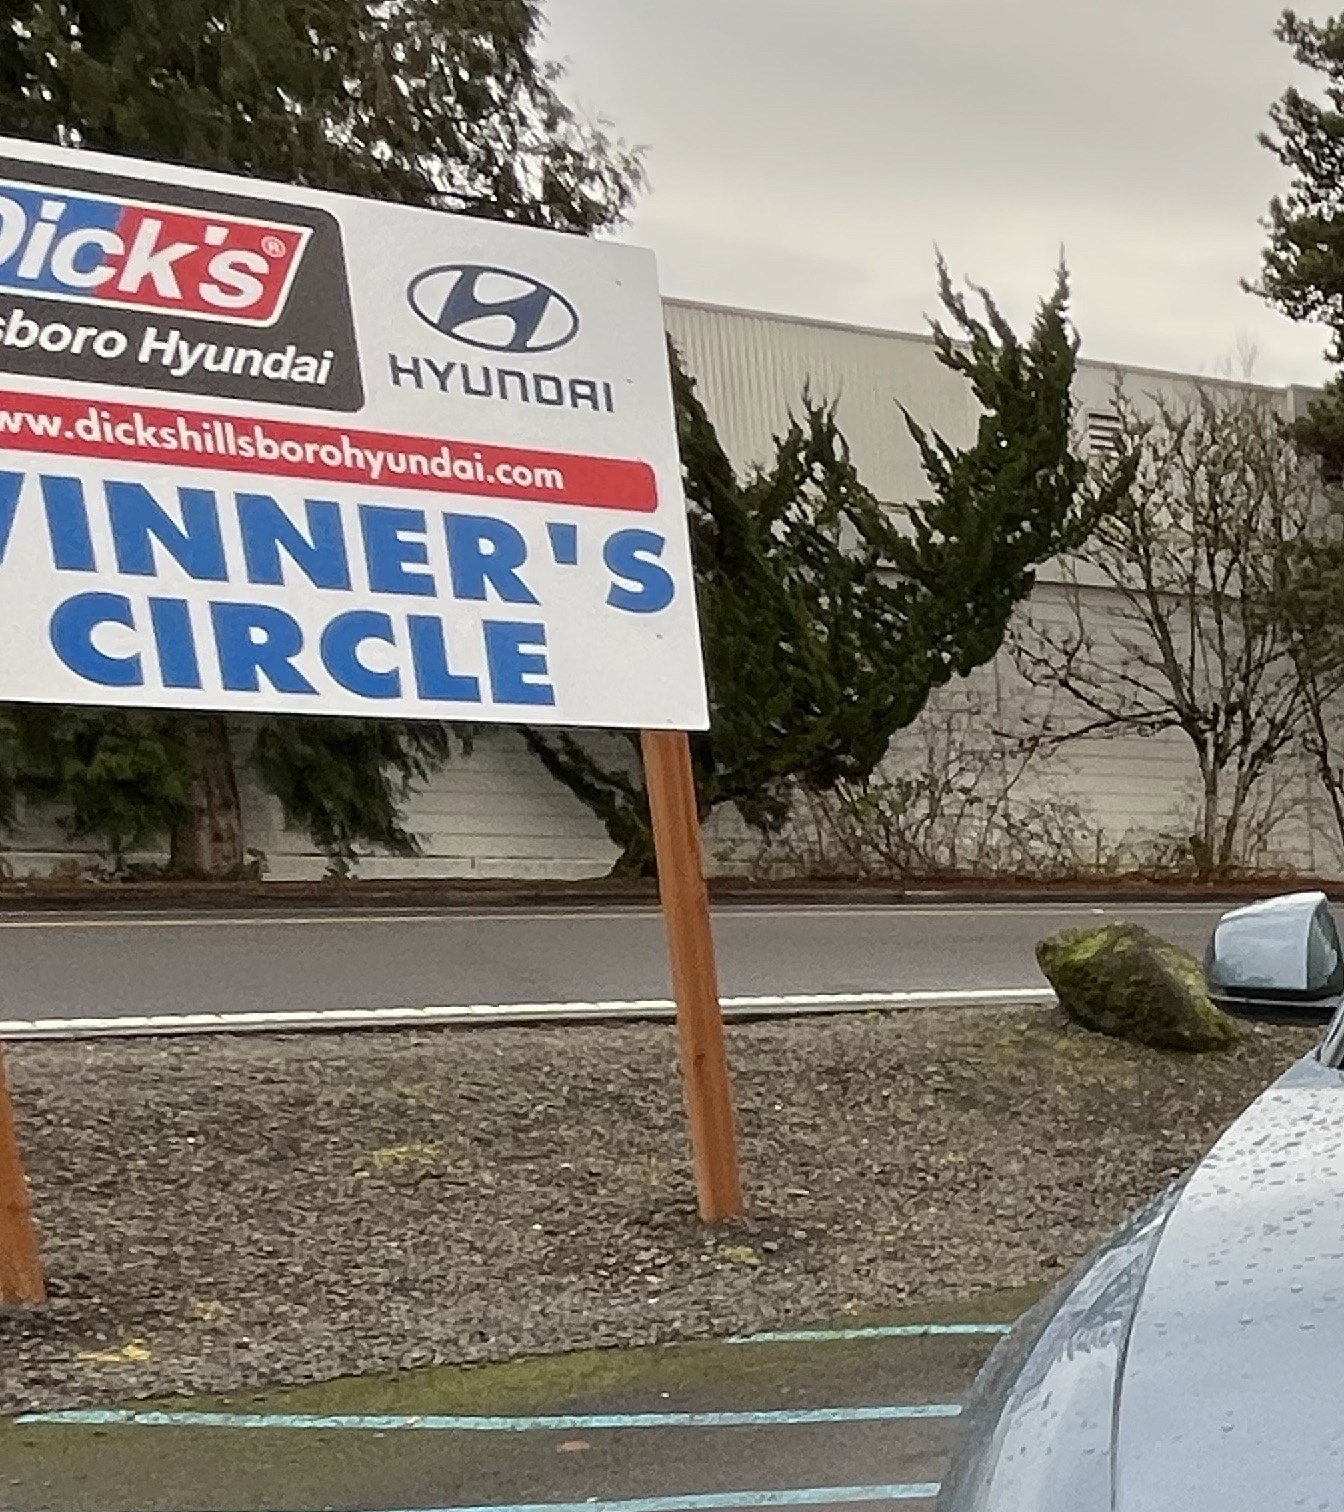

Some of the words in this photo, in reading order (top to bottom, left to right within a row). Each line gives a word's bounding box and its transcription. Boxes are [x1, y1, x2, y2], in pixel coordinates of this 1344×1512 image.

[0, 308, 128, 359] boro
[138, 326, 335, 386] Hyundai
[387, 353, 615, 413] HYUNDAI
[0, 470, 676, 614] INNER'S
[49, 591, 556, 706] CIRCLE
